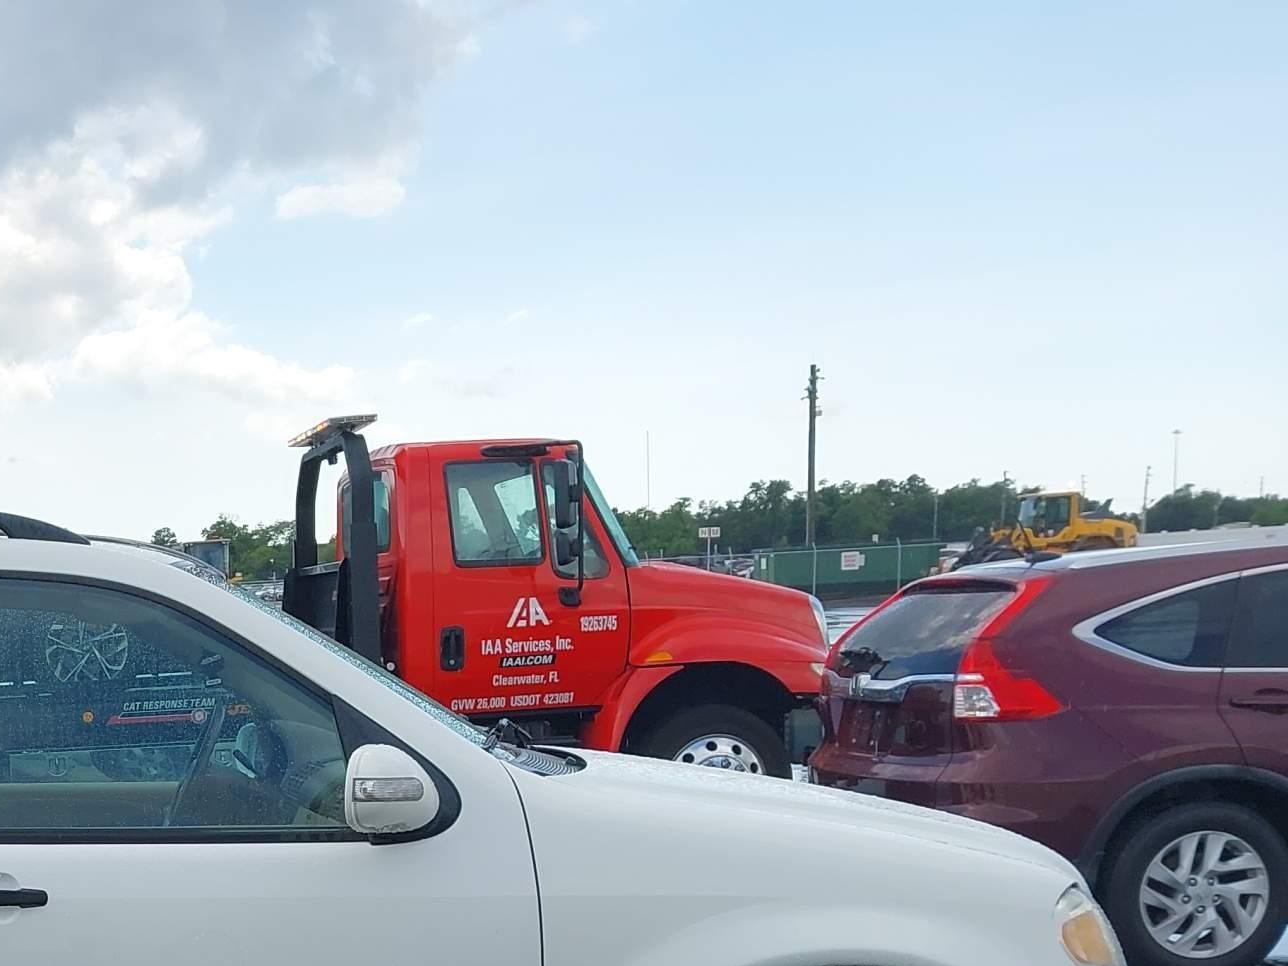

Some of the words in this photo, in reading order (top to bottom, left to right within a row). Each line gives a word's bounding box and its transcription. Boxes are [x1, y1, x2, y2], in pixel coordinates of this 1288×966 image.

[580, 615, 618, 632] 19263745
[481, 638, 503, 655] IAA
[505, 637, 554, 653] Services,
[555, 635, 574, 650] Inc.
[502, 654, 553, 667] IAAI.COM
[492, 673, 547, 687] Clearwater,
[549, 671, 560, 683] FL
[123, 701, 141, 712] CAT
[142, 699, 189, 711] RESPONSE
[189, 697, 215, 708] TEAM
[451, 698, 475, 711] GVW
[476, 696, 506, 710] 26,000
[510, 694, 540, 707] USDOT
[543, 691, 574, 705] 423081
